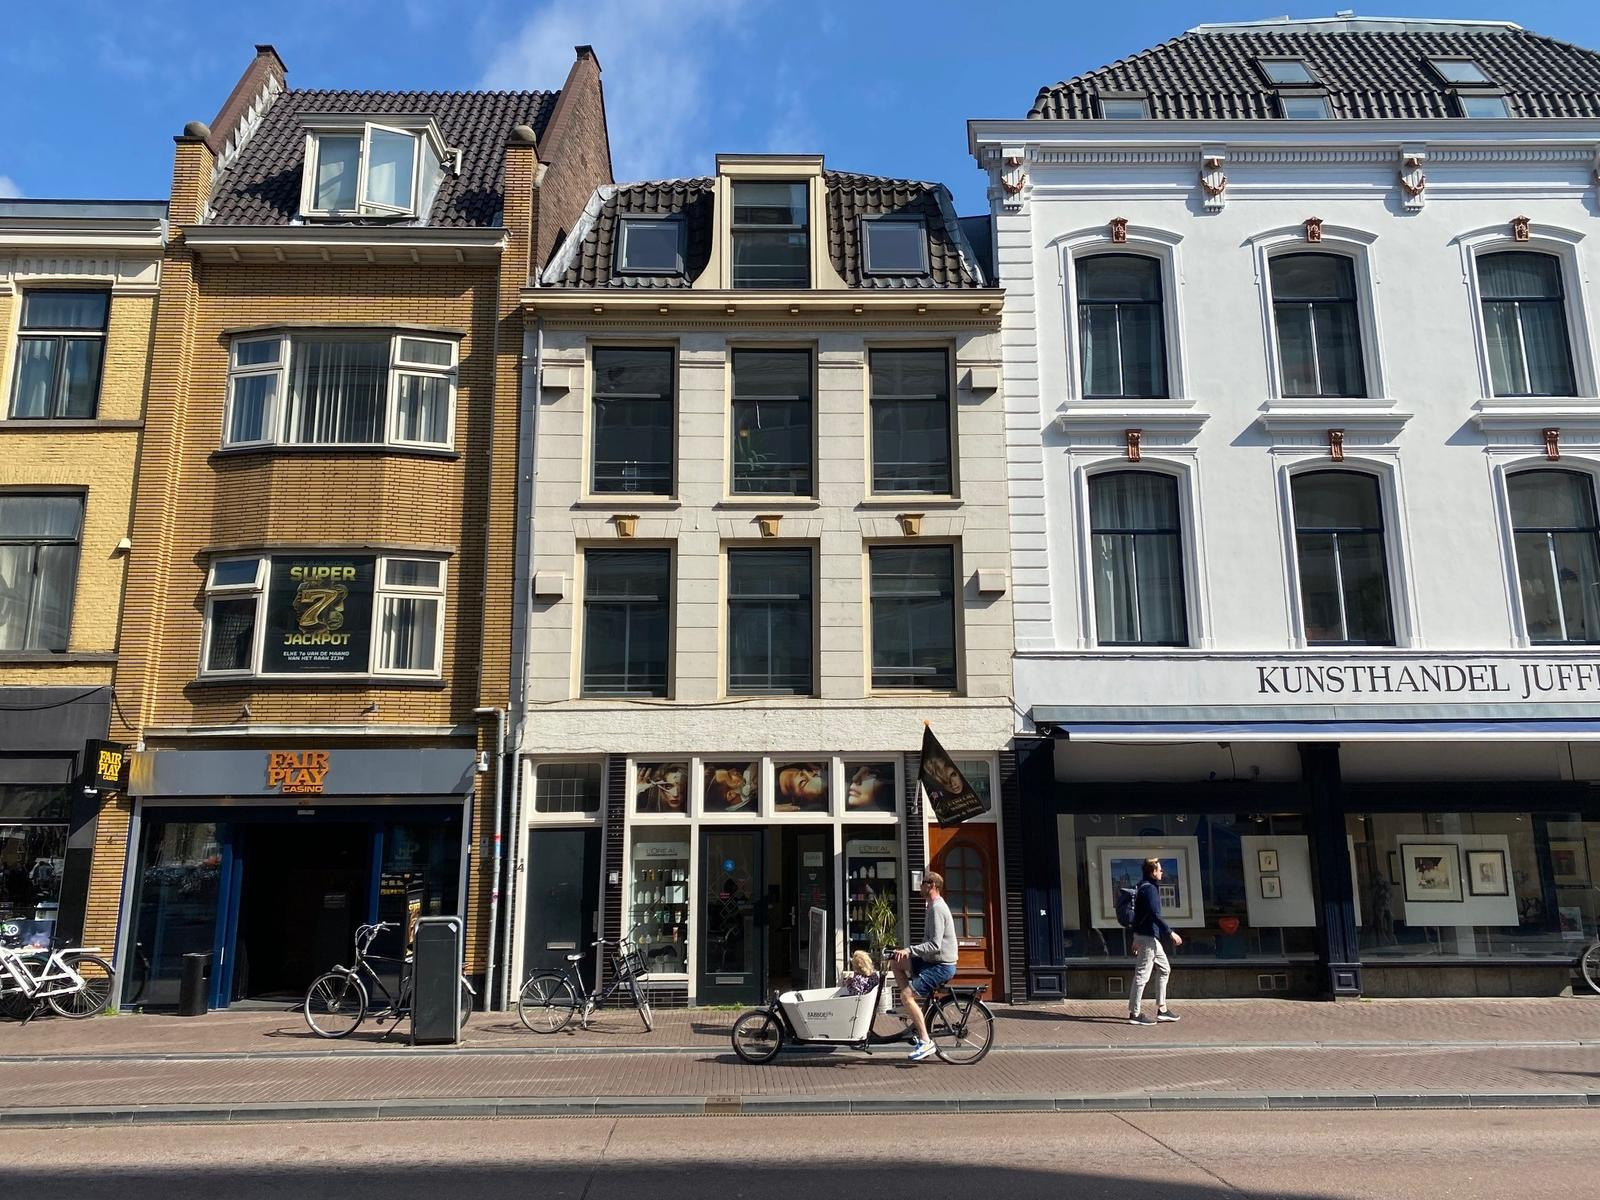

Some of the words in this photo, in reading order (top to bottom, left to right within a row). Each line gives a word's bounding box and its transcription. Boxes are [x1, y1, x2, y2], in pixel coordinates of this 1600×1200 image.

[290, 566, 356, 580] SUPER
[283, 633, 351, 645] JACKPOT
[1256, 664, 1510, 693] KUNSTHANDEL
[100, 751, 122, 765] FAIR
[269, 751, 330, 767] FAIR
[98, 762, 121, 776] PLAY
[268, 766, 329, 785] PLAY
[282, 785, 324, 793] CASINO
